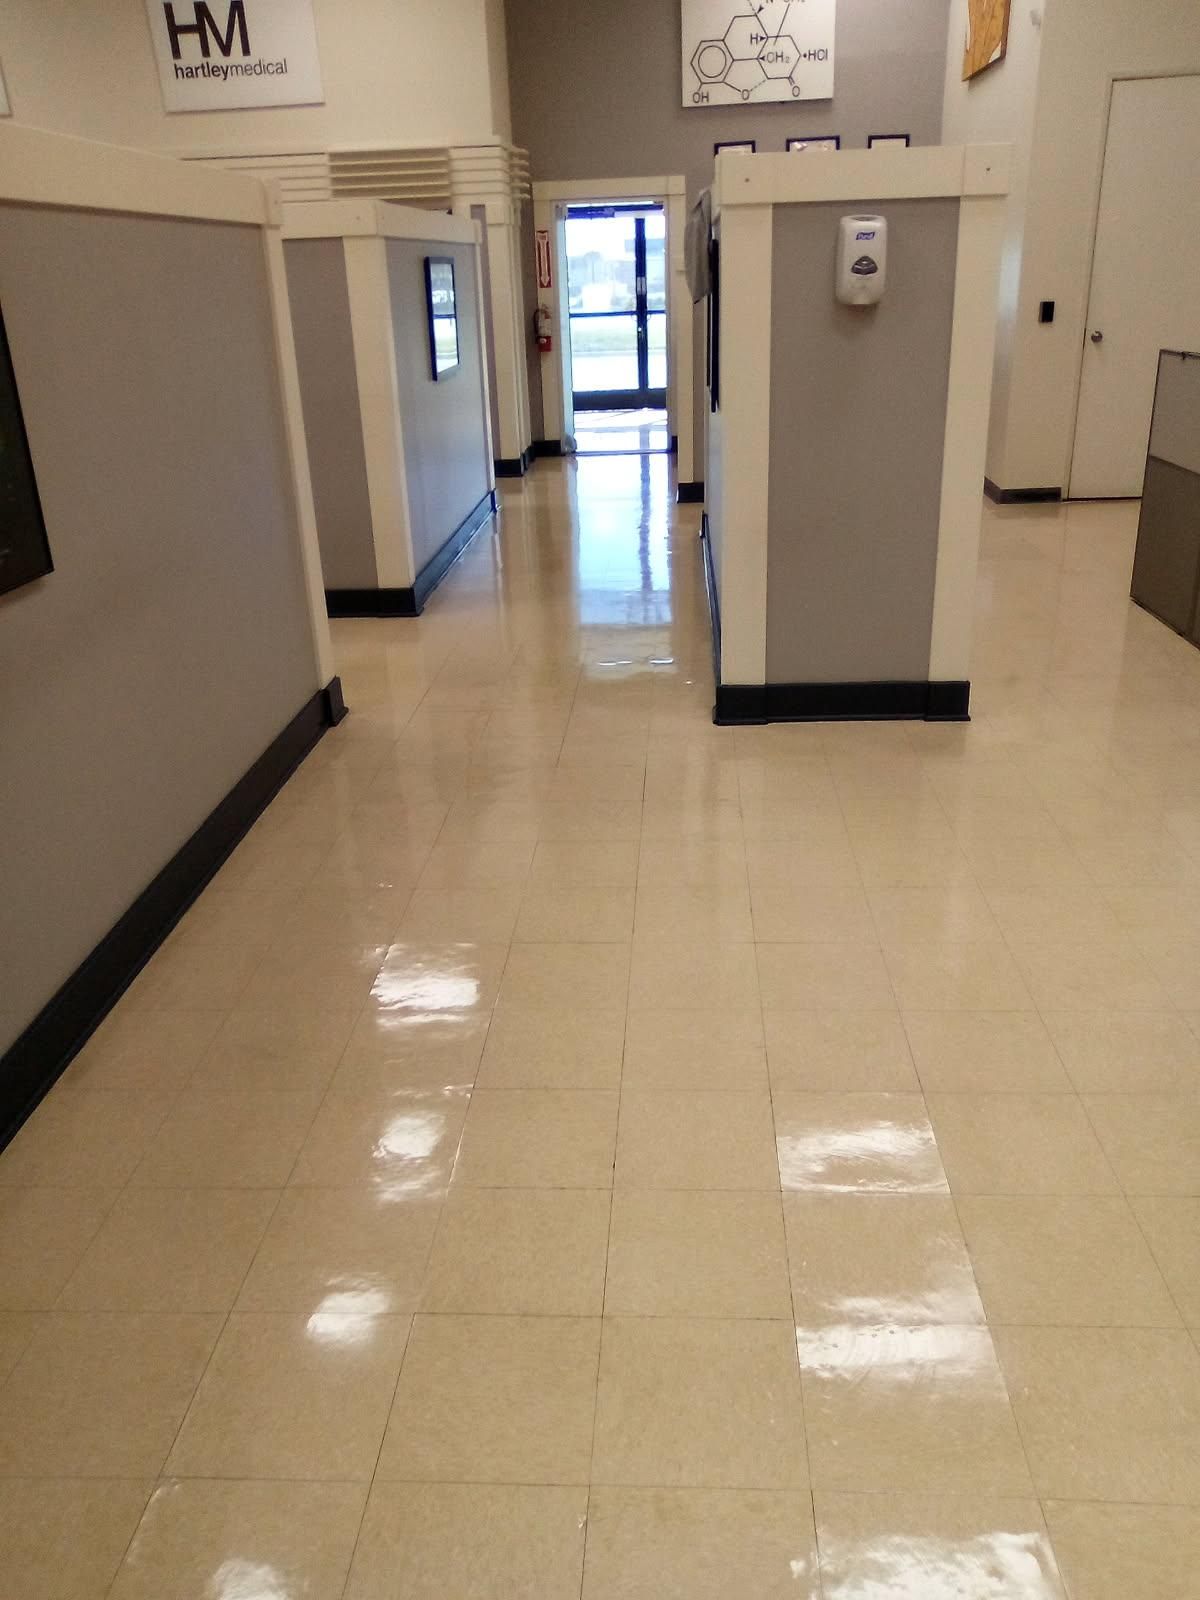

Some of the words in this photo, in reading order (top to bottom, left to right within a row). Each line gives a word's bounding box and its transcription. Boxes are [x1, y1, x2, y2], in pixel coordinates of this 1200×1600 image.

[163, 0, 251, 60] HM
[750, 33, 759, 45] H
[174, 58, 288, 80] hartleymedical
[692, 92, 710, 104] OH
